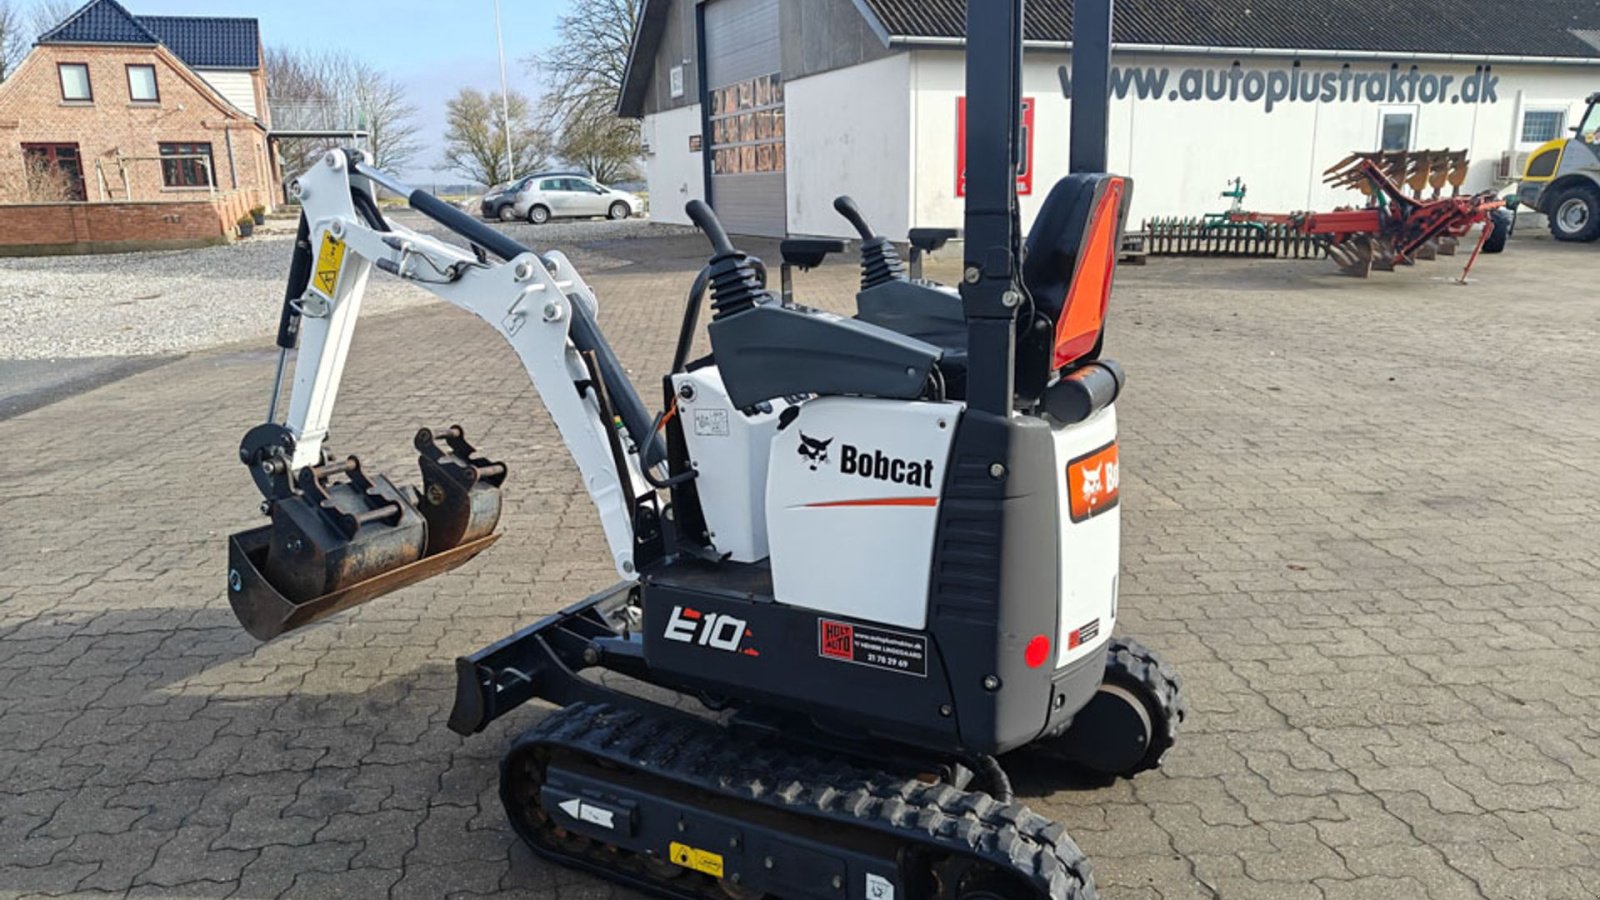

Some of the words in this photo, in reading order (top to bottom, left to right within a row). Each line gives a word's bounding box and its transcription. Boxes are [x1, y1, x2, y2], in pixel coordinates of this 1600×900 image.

[840, 444, 933, 489] Bobcat
[664, 606, 746, 651] E10
[826, 623, 851, 640] HOLT
[825, 635, 851, 652] AUTO
[867, 653, 876, 661] 21
[887, 657, 897, 666] 29
[898, 659, 909, 668] 69
